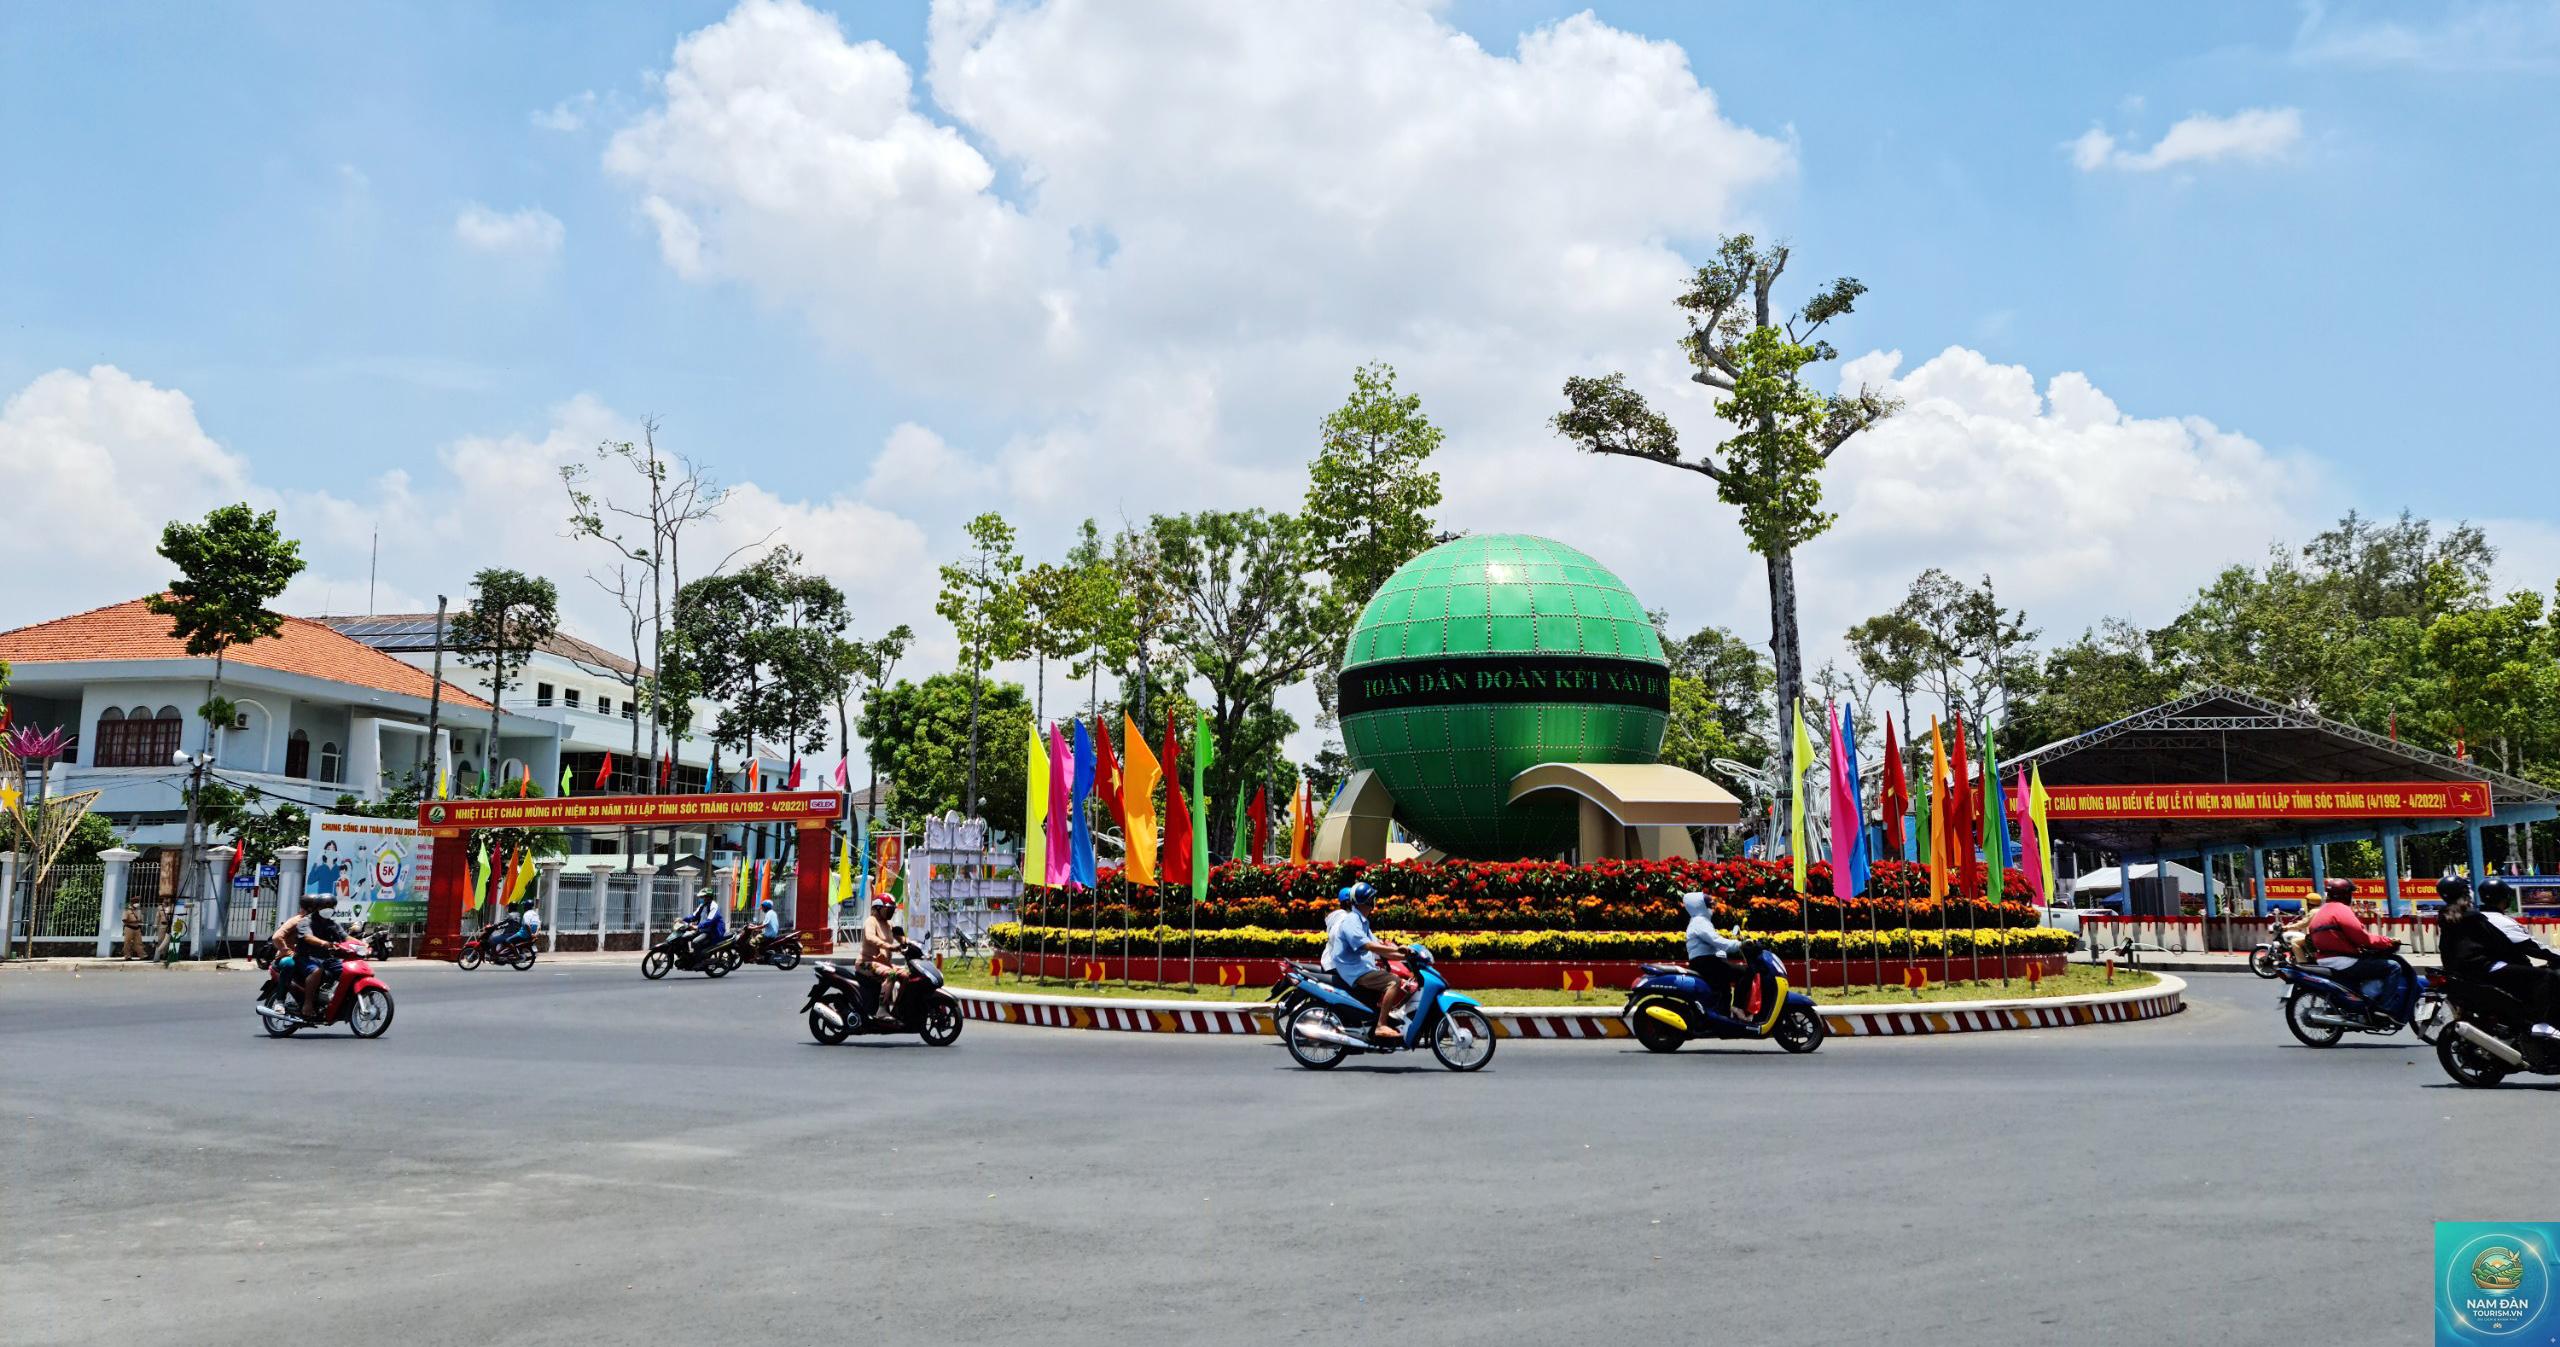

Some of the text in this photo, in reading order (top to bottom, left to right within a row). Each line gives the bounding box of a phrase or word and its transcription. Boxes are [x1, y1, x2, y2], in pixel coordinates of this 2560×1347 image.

[1363, 672, 1412, 699] TOÀN
[1418, 667, 1467, 692] DÂN
[1476, 665, 1548, 689] ĐOÀN
[1554, 665, 1601, 689] KẾT
[1607, 667, 1643, 692] XÂY
[455, 807, 480, 821] NHIỆT
[481, 806, 498, 820] LIỆT
[500, 806, 523, 818] CHÀO
[525, 805, 550, 817] MỪNG
[565, 804, 587, 819] NIỆM
[588, 805, 600, 816] 30
[601, 803, 621, 816] NĂM
[624, 802, 637, 815] TÁI
[639, 801, 655, 817] LẬP
[658, 800, 678, 814] TỈNH
[680, 801, 698, 814] SÓC
[700, 800, 729, 814] TRĂNG
[731, 800, 764, 814] (4/1992
[772, 799, 808, 813] 4/2022)!
[2054, 794, 2077, 811] CHÀO
[2078, 793, 2104, 811] MỪNG
[2106, 796, 2121, 814] ĐẠI
[2122, 790, 2142, 810] BIỂU
[2144, 791, 2155, 810] VỀ
[2157, 795, 2169, 813] DỰ
[2170, 790, 2181, 809] LỄ
[2196, 792, 2219, 812] NIỆM
[2221, 794, 2232, 809] 30
[2234, 792, 2255, 809] NĂM
[2256, 791, 2271, 809] TÁI
[2273, 791, 2289, 813] LẬP
[2292, 790, 2312, 809] TỈNH
[2314, 791, 2333, 809] SÓC
[2334, 791, 2365, 809] TRĂNG
[2367, 793, 2401, 810] (4/1992
[2409, 793, 2447, 810] 4/2022)!
[321, 822, 342, 832] CHUNG
[342, 821, 359, 833] SỐNG
[360, 825, 368, 833] AN
[369, 824, 384, 835] TOÀN
[382, 866, 395, 876] 5K
